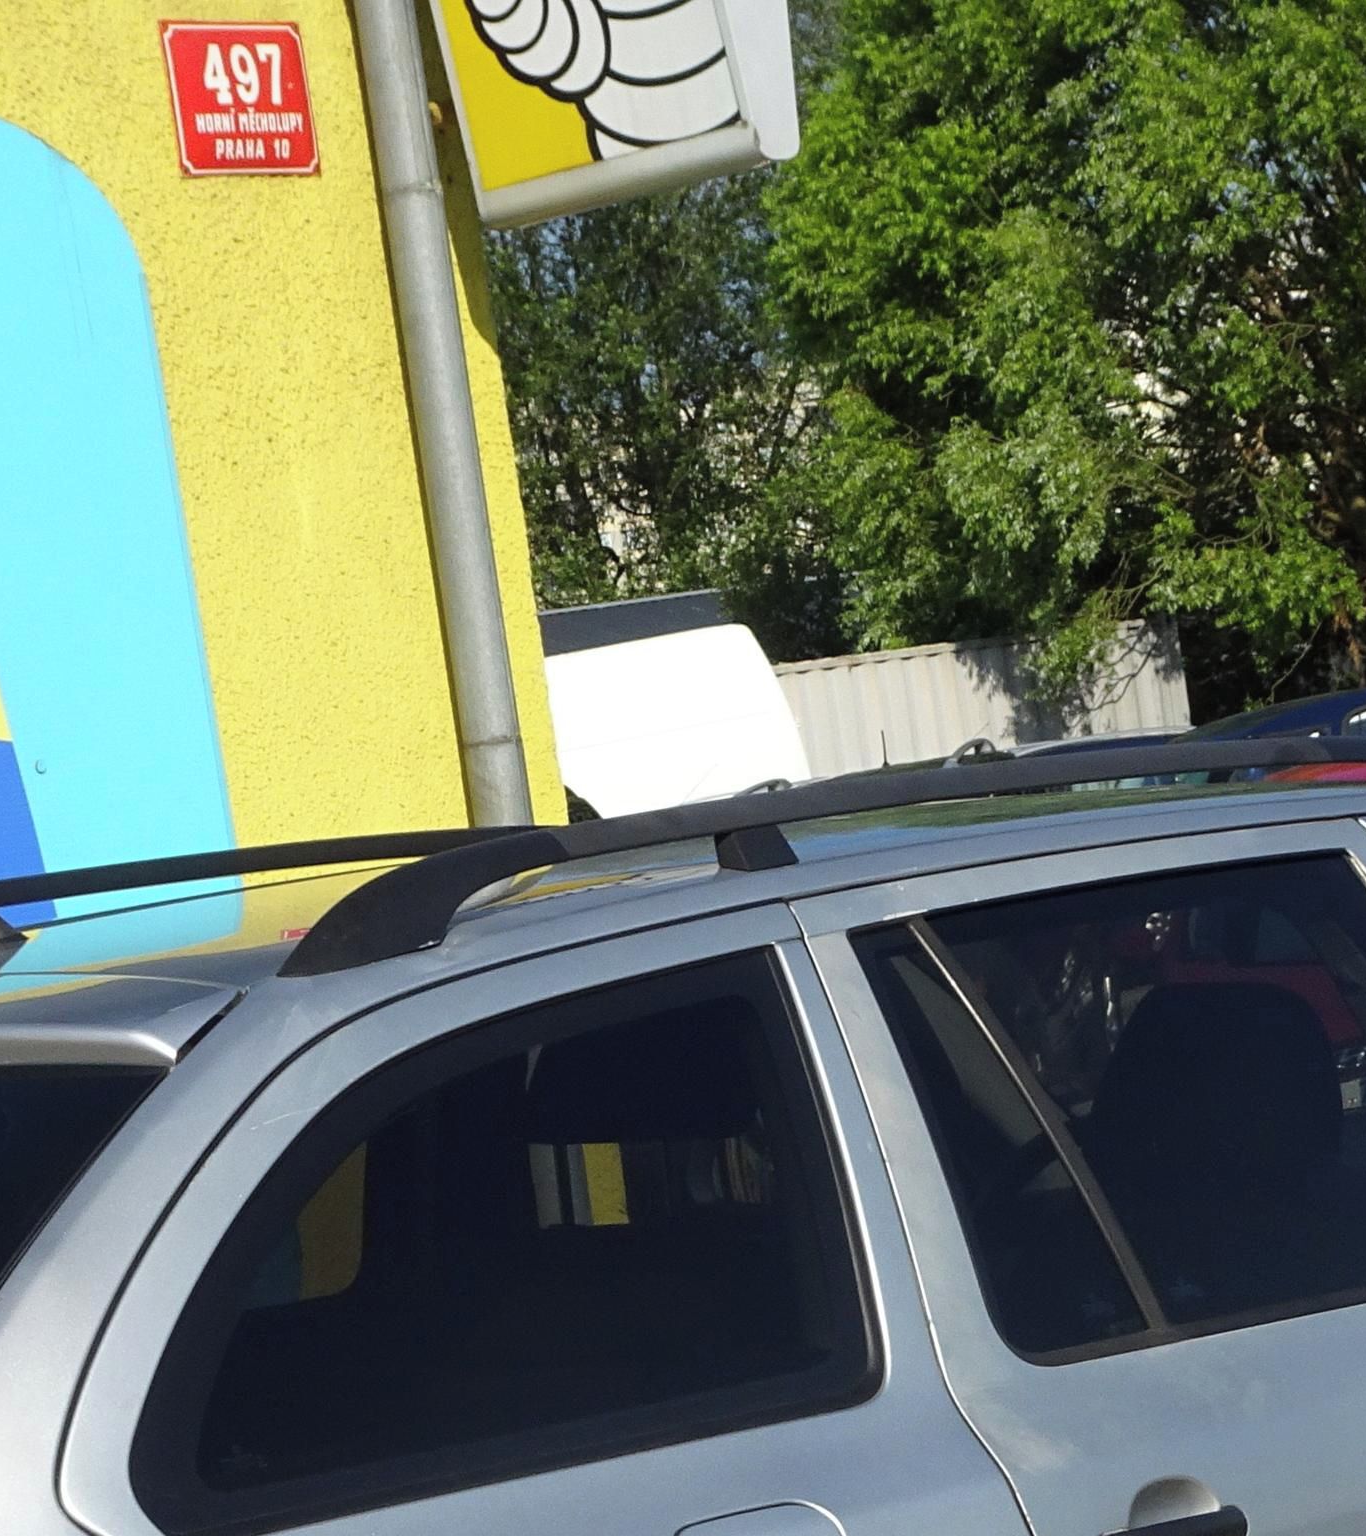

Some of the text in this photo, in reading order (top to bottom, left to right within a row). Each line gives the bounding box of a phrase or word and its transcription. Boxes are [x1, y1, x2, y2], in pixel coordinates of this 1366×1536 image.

[203, 42, 283, 106] 497
[195, 107, 304, 134] HORNÍ MĚCHOLUPY
[214, 138, 291, 160] PRAHA 10
